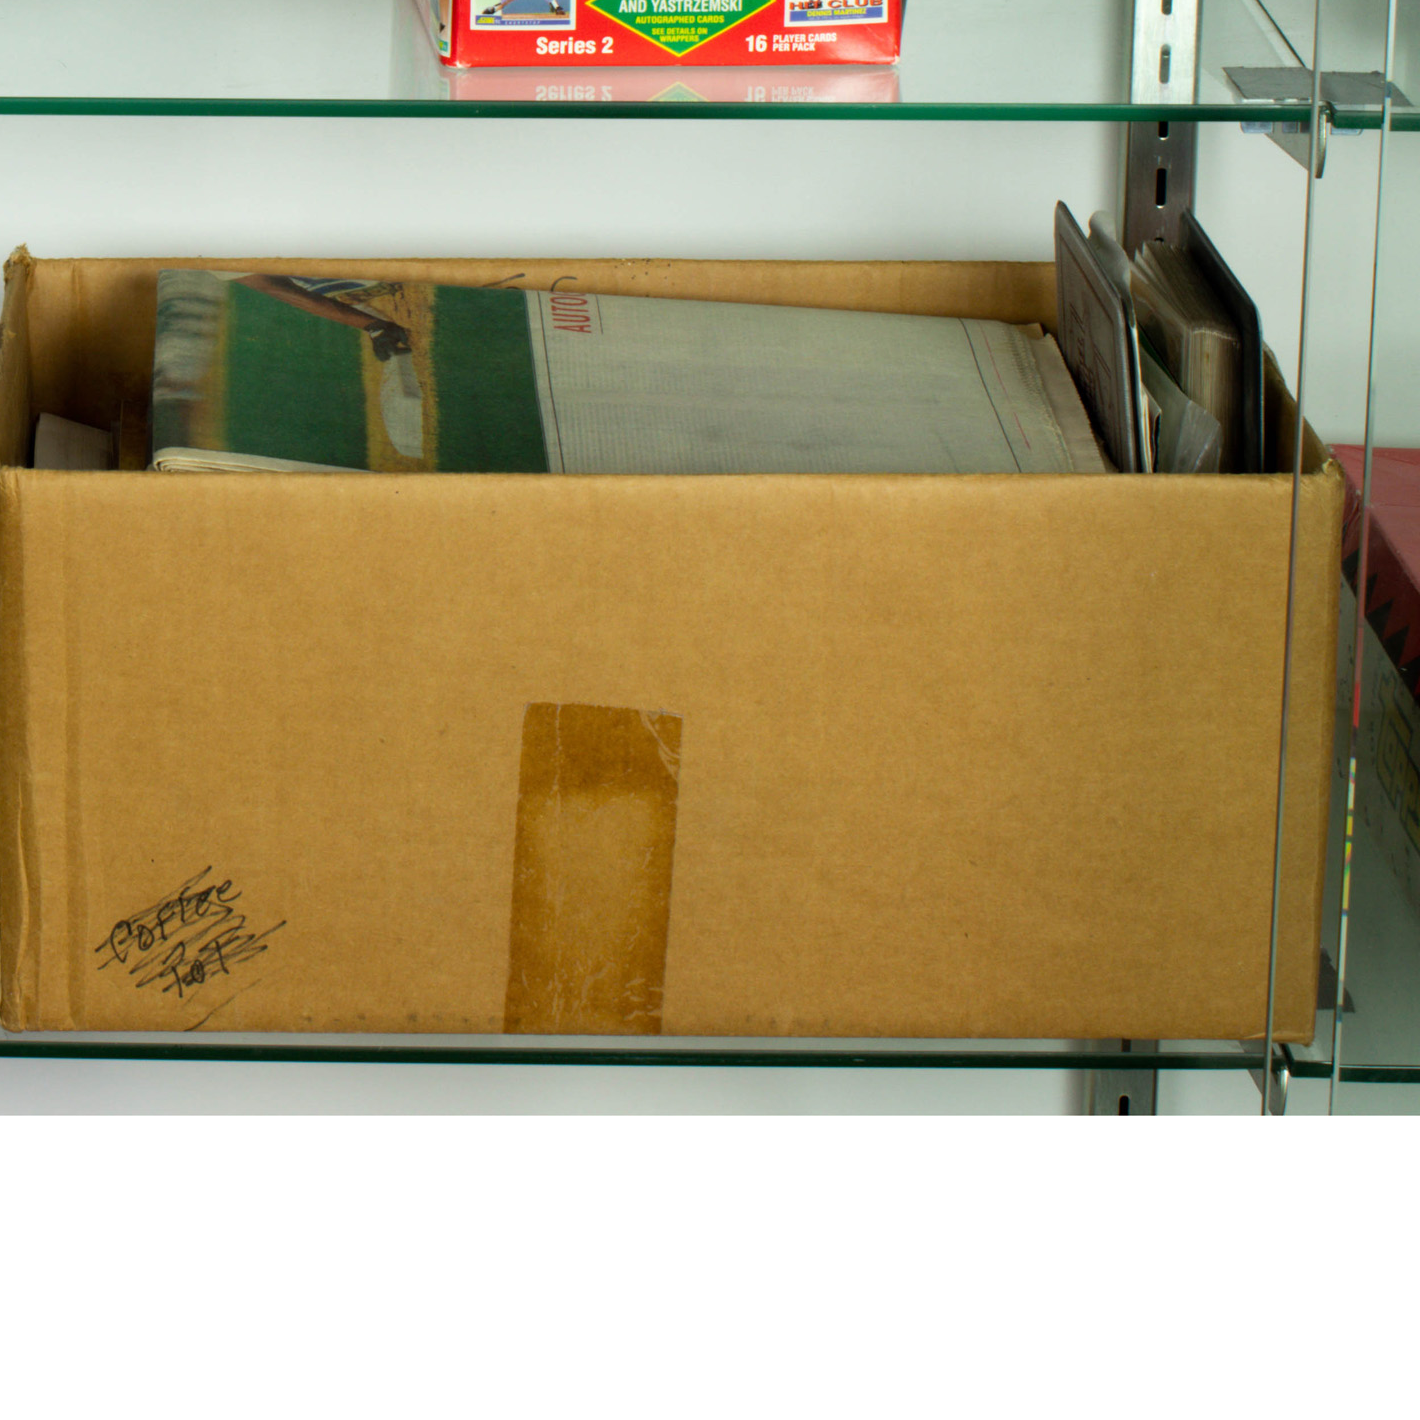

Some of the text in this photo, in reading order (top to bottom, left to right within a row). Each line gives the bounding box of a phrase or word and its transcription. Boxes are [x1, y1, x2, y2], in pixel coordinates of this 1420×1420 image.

[619, 0, 647, 13] AND
[834, 8, 867, 16] MARTINEZ
[635, 15, 724, 24] AUTOGRAPHED CARDS
[651, 27, 665, 35] SEE
[666, 27, 695, 35] DETAILS
[773, 32, 837, 43] PLAYER CARDS
[535, 36, 613, 56] Series 2
[745, 35, 767, 52] 16
[773, 42, 815, 52] PER PACK
